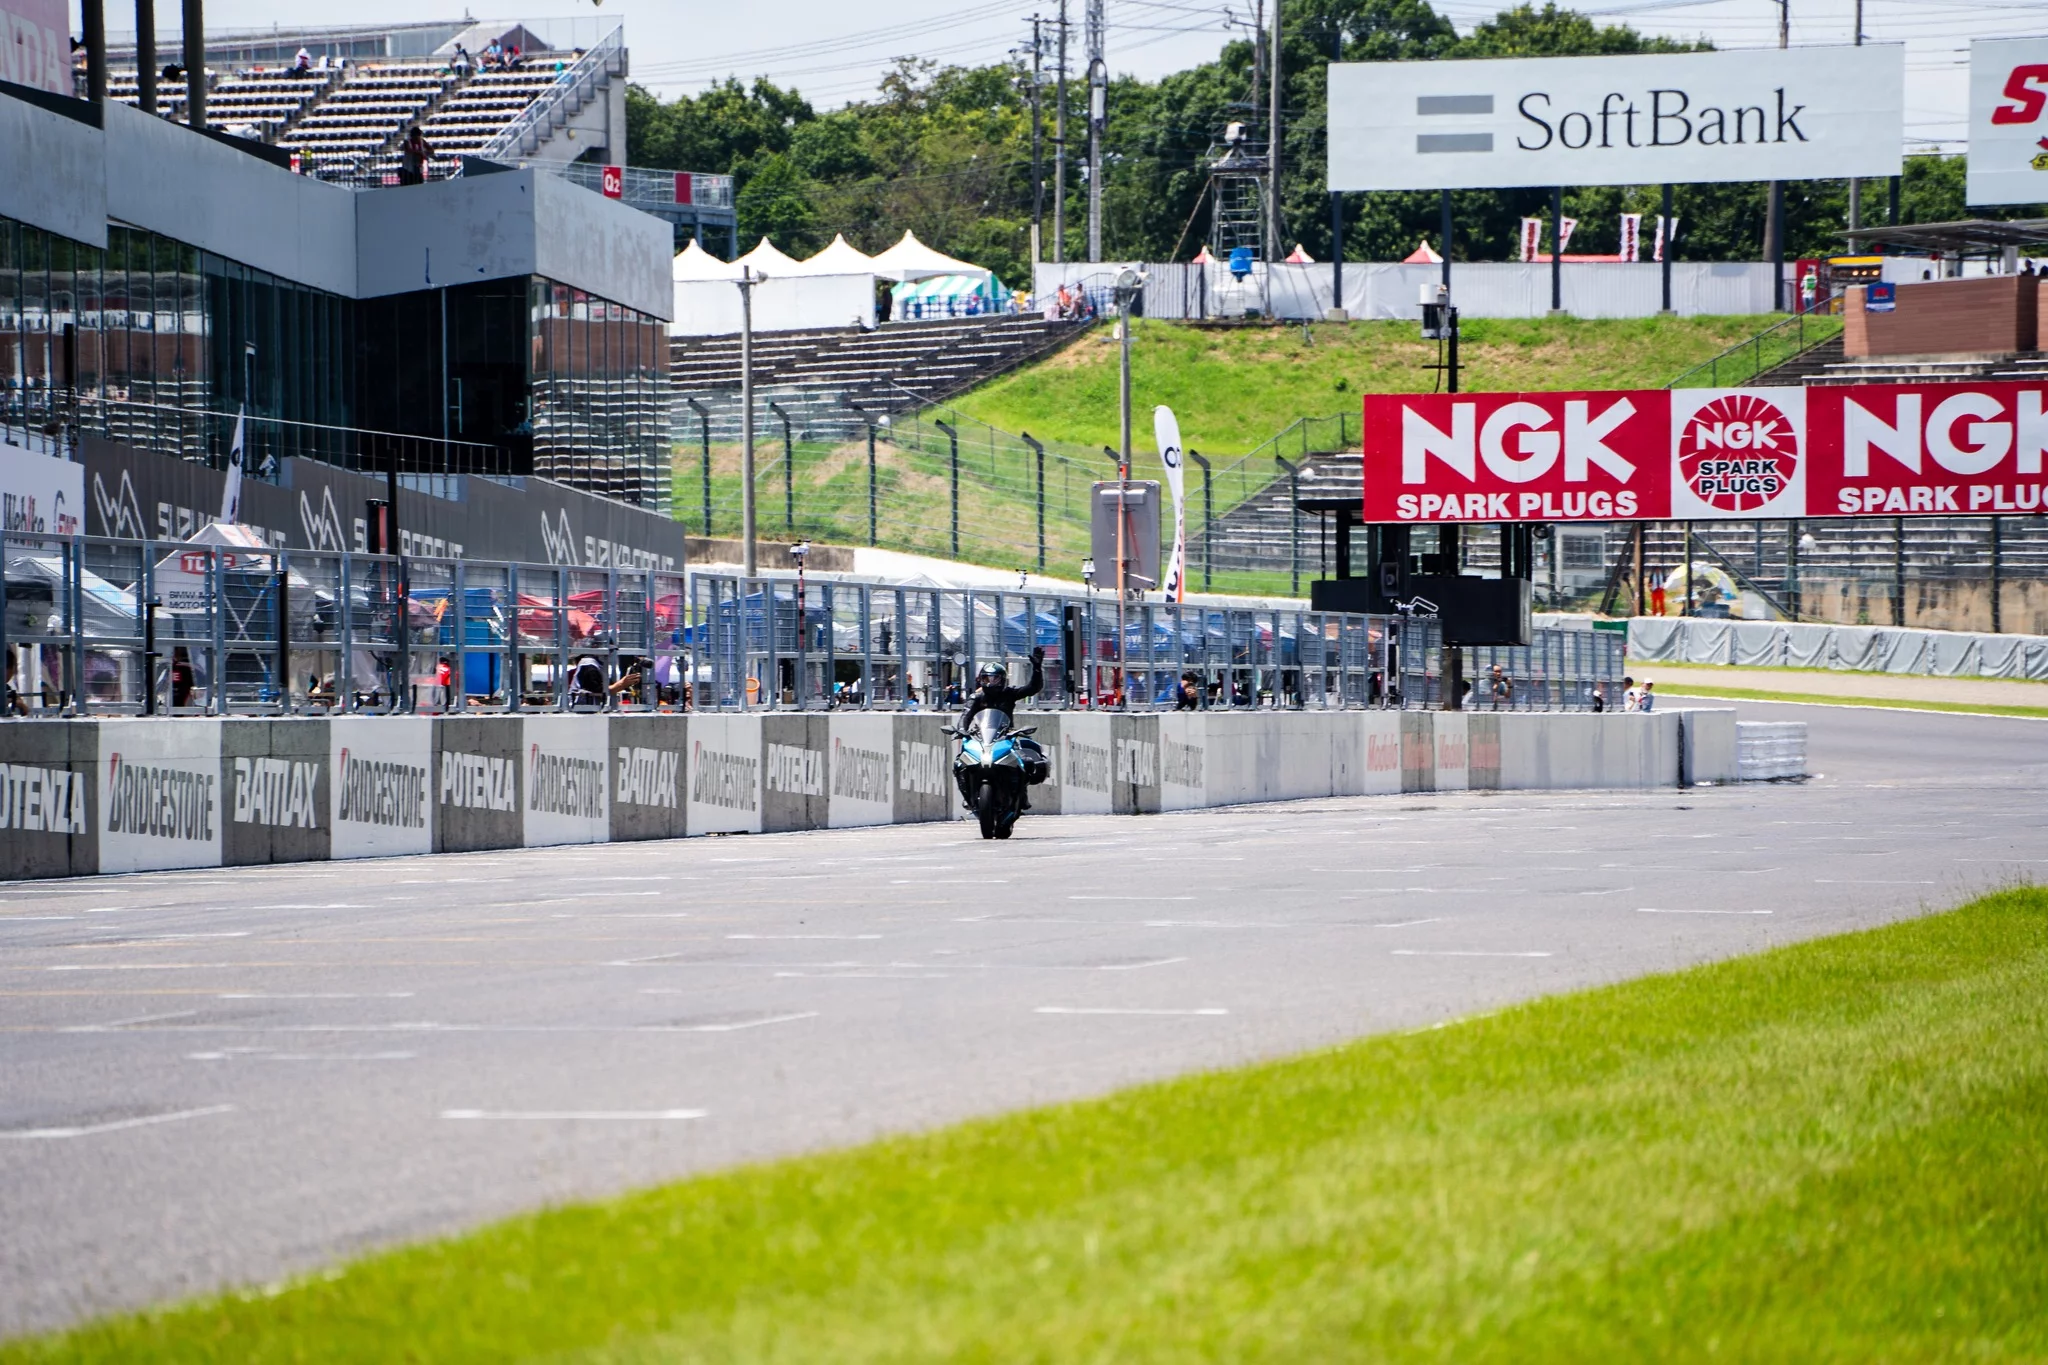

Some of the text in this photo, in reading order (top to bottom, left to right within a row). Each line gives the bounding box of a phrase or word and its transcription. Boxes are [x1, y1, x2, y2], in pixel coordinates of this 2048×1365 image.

[1517, 87, 1809, 151] SoftBank
[604, 173, 621, 193] Q2
[1402, 397, 1637, 484] NGK
[1696, 419, 1778, 450] NGK
[1700, 459, 1777, 476] SPARK
[1700, 477, 1777, 494] PLUGS
[1838, 484, 2048, 513] SPARK PLU
[1397, 491, 1638, 519] SPARK PLUGS
[108, 752, 214, 841] BRIDGESTONE
[234, 757, 318, 829] BATTLAX
[339, 748, 426, 828] BRIDGESTONE
[441, 750, 516, 812] POTENZA
[530, 743, 604, 818] BRIDGESTONE
[617, 746, 680, 808] BATTLAX
[693, 740, 757, 811] BRIDGESTONE
[767, 743, 823, 796] POTENZA
